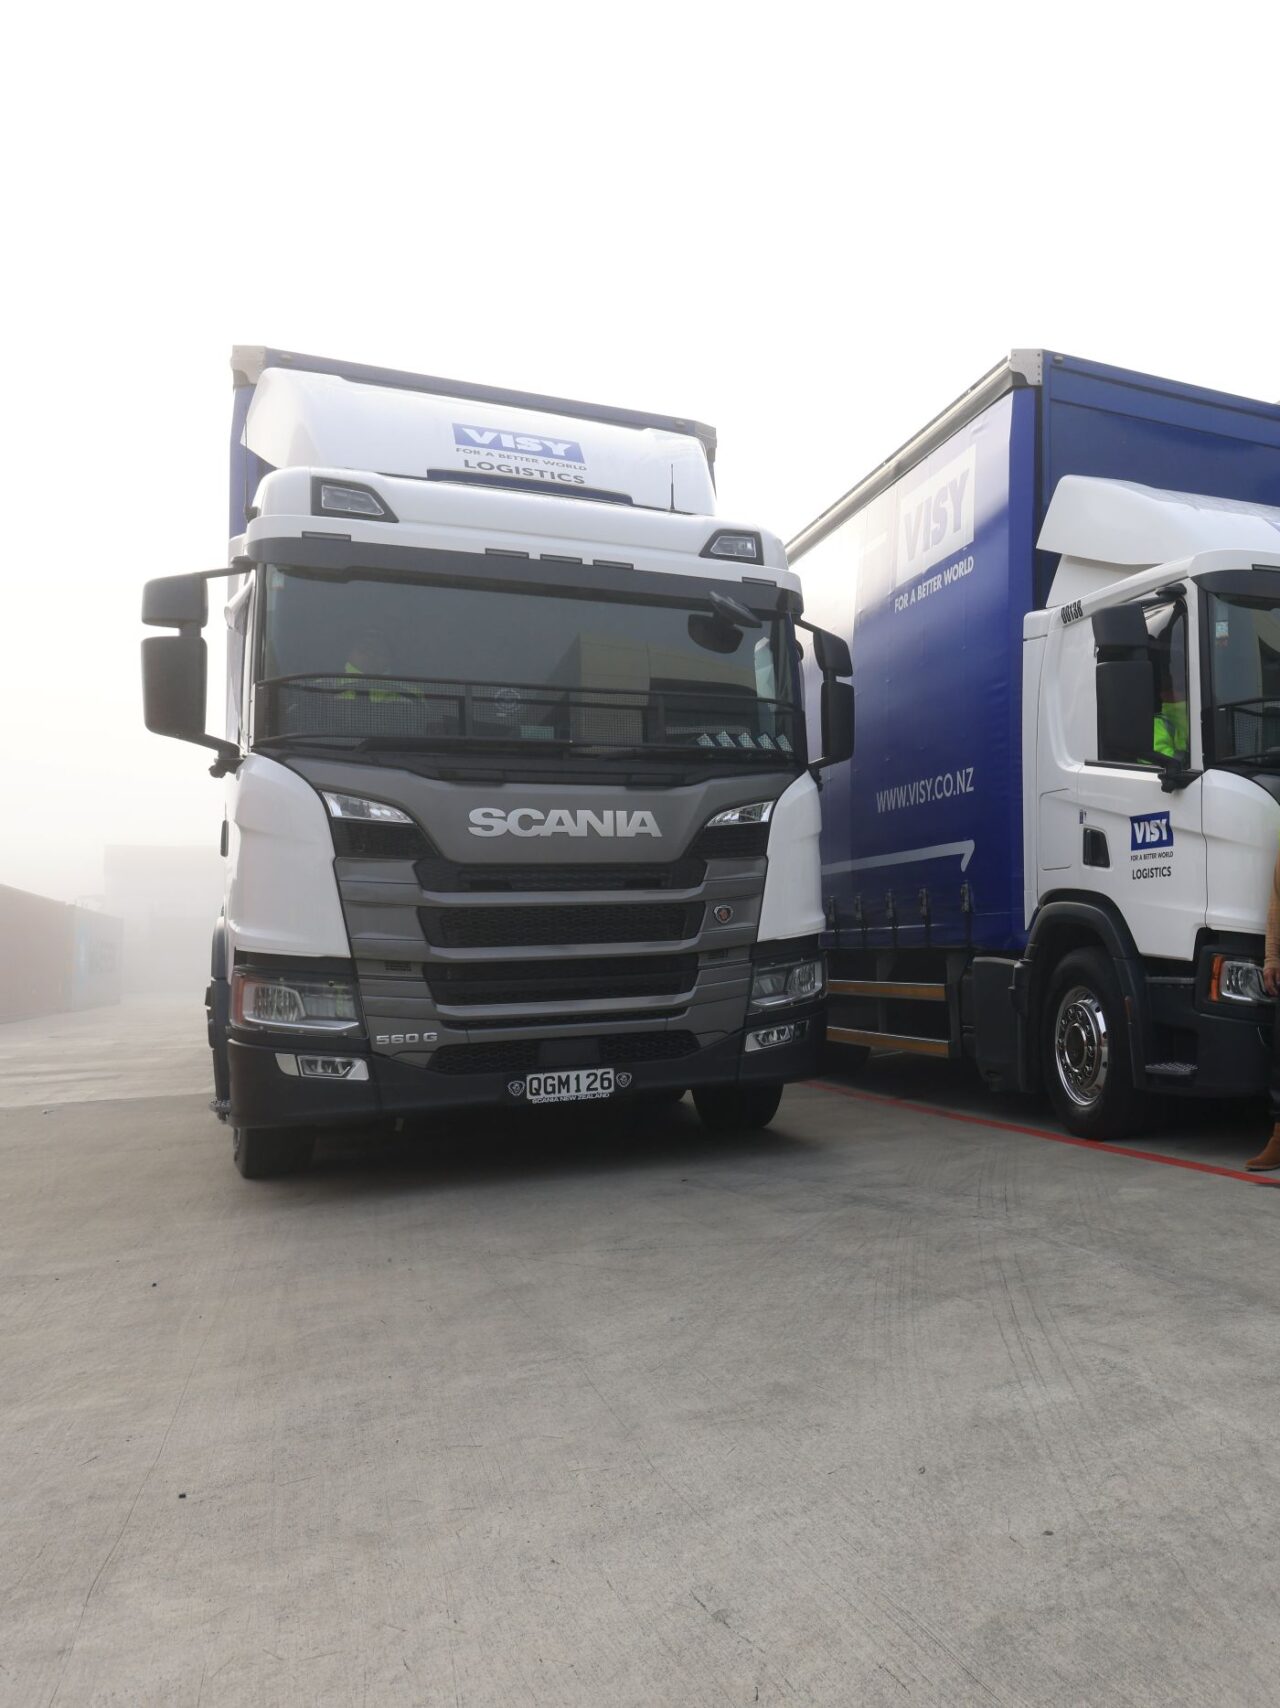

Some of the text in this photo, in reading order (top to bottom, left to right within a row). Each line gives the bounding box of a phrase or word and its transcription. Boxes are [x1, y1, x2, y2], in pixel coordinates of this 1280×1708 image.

[462, 427, 572, 456] VISY
[464, 460, 585, 484] LOGISTICS
[499, 453, 539, 464] BETTER
[543, 459, 587, 471] WORLD
[904, 468, 969, 562] VISY
[894, 555, 974, 613] FOR A BETTER WORLD
[876, 766, 975, 814] WWW.VISY.CO.NZ
[468, 807, 663, 838] SCANIA
[1133, 819, 1168, 844] VISY
[1132, 866, 1171, 880] LOGISTICS
[376, 1032, 438, 1045] 560 G
[528, 1071, 613, 1097] QGM126
[578, 1092, 610, 1101] ZEALAND
